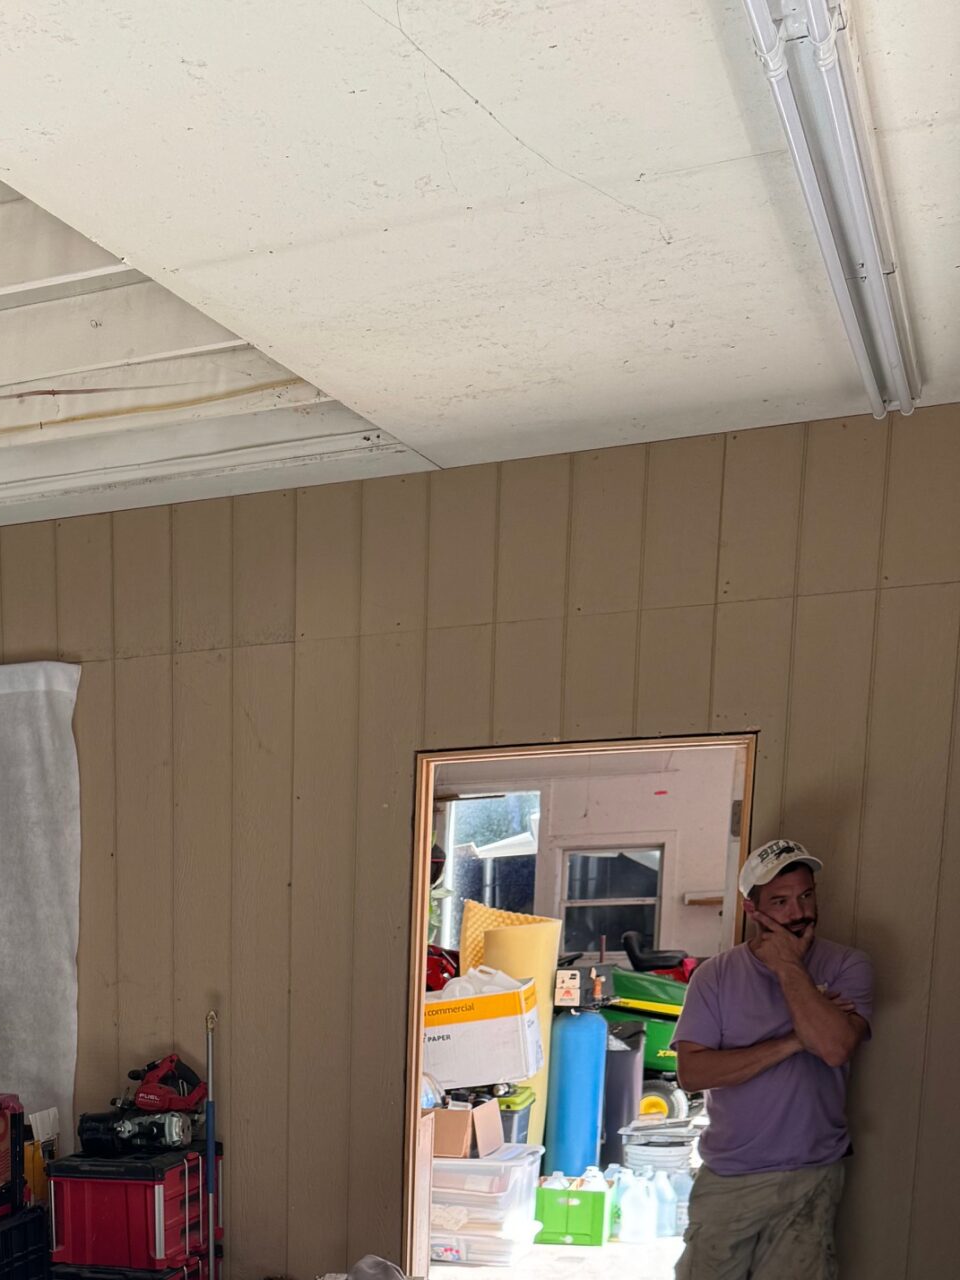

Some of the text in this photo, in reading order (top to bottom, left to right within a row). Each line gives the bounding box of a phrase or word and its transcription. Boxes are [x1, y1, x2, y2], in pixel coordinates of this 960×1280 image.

[427, 1002, 475, 1017] commercial
[427, 1034, 451, 1043] PAPER
[139, 1093, 160, 1101] FUEL
